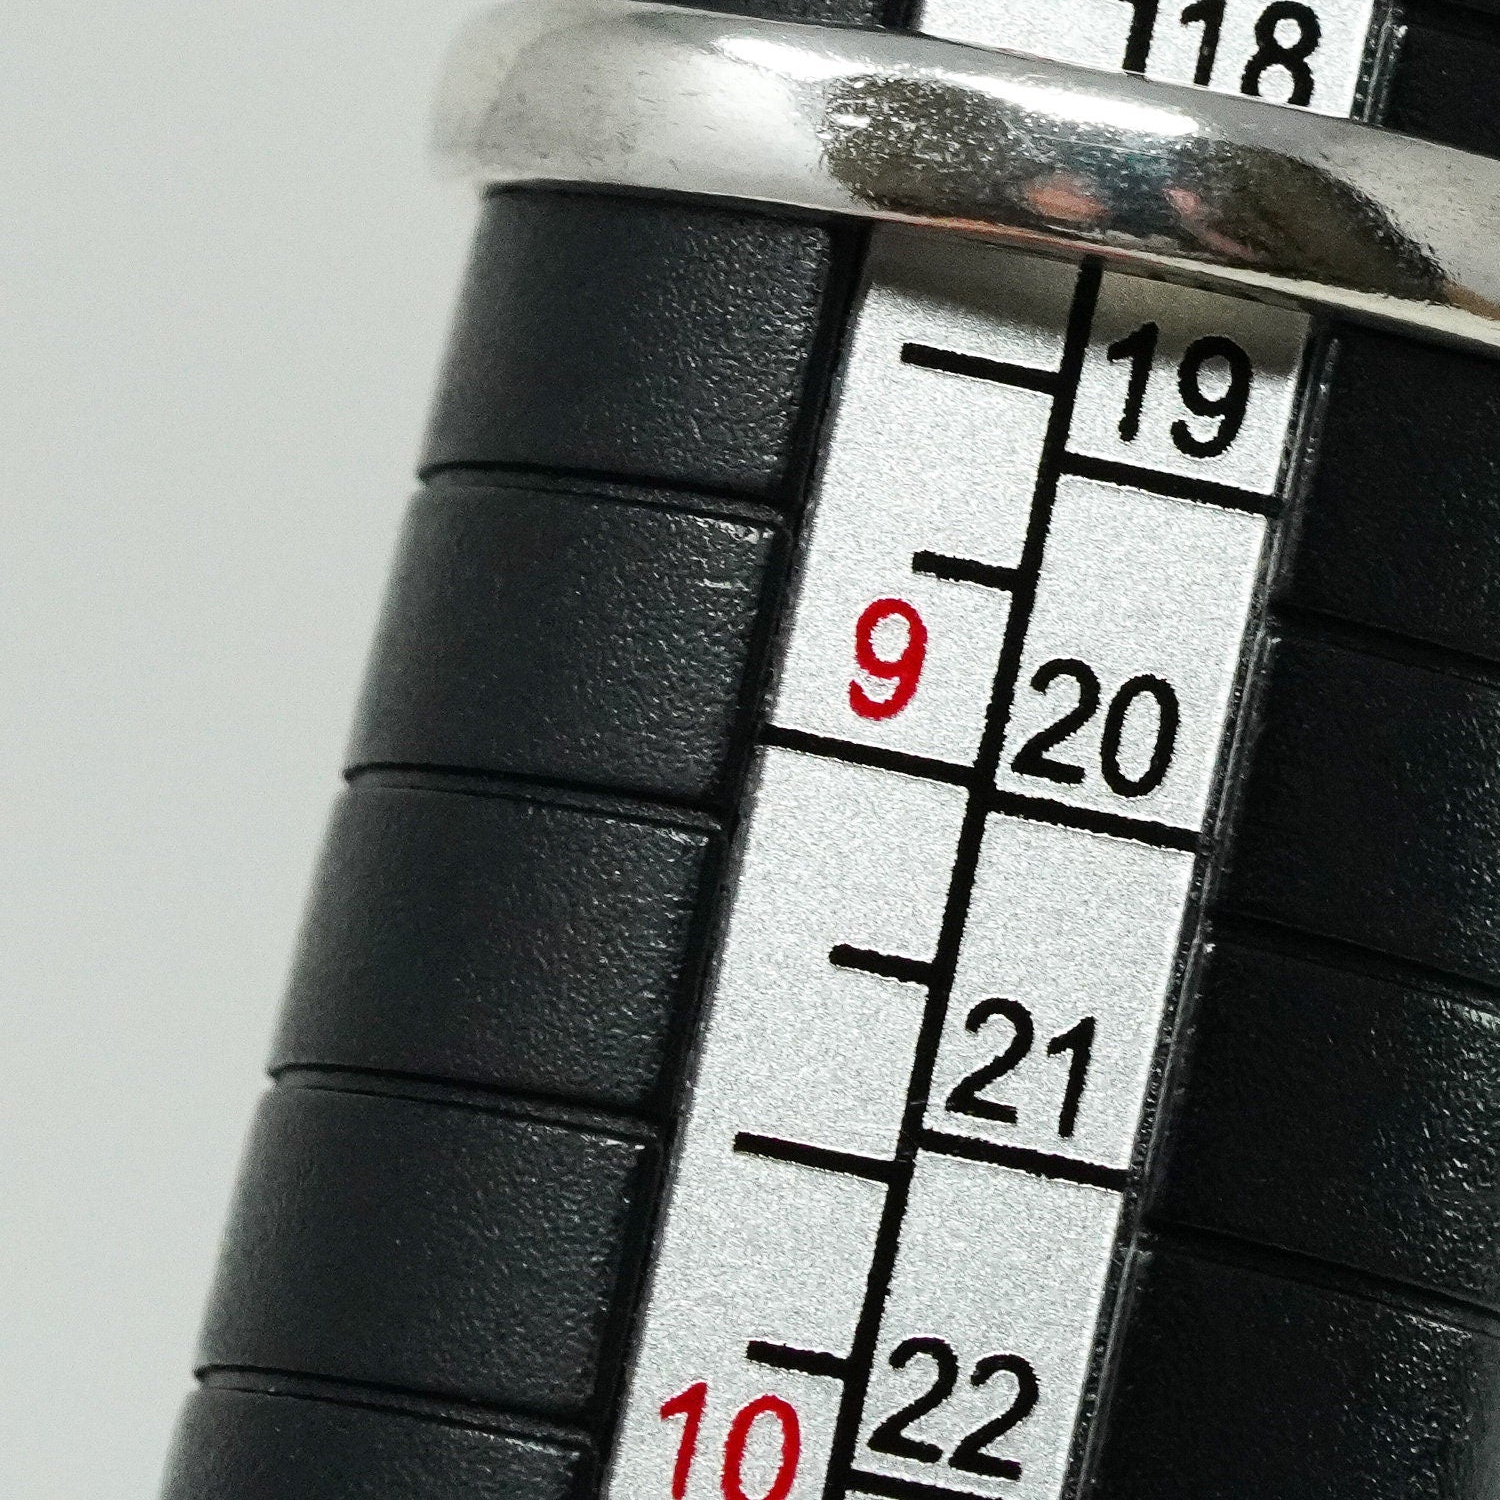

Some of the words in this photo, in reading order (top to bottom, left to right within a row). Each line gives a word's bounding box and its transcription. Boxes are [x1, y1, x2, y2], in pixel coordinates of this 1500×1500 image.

[1107, 322, 1255, 457] 19
[847, 598, 929, 722] 9
[1011, 657, 1180, 797] 20
[945, 997, 1098, 1137] 21
[659, 1381, 802, 1500] 10
[867, 1336, 1041, 1482] 22
